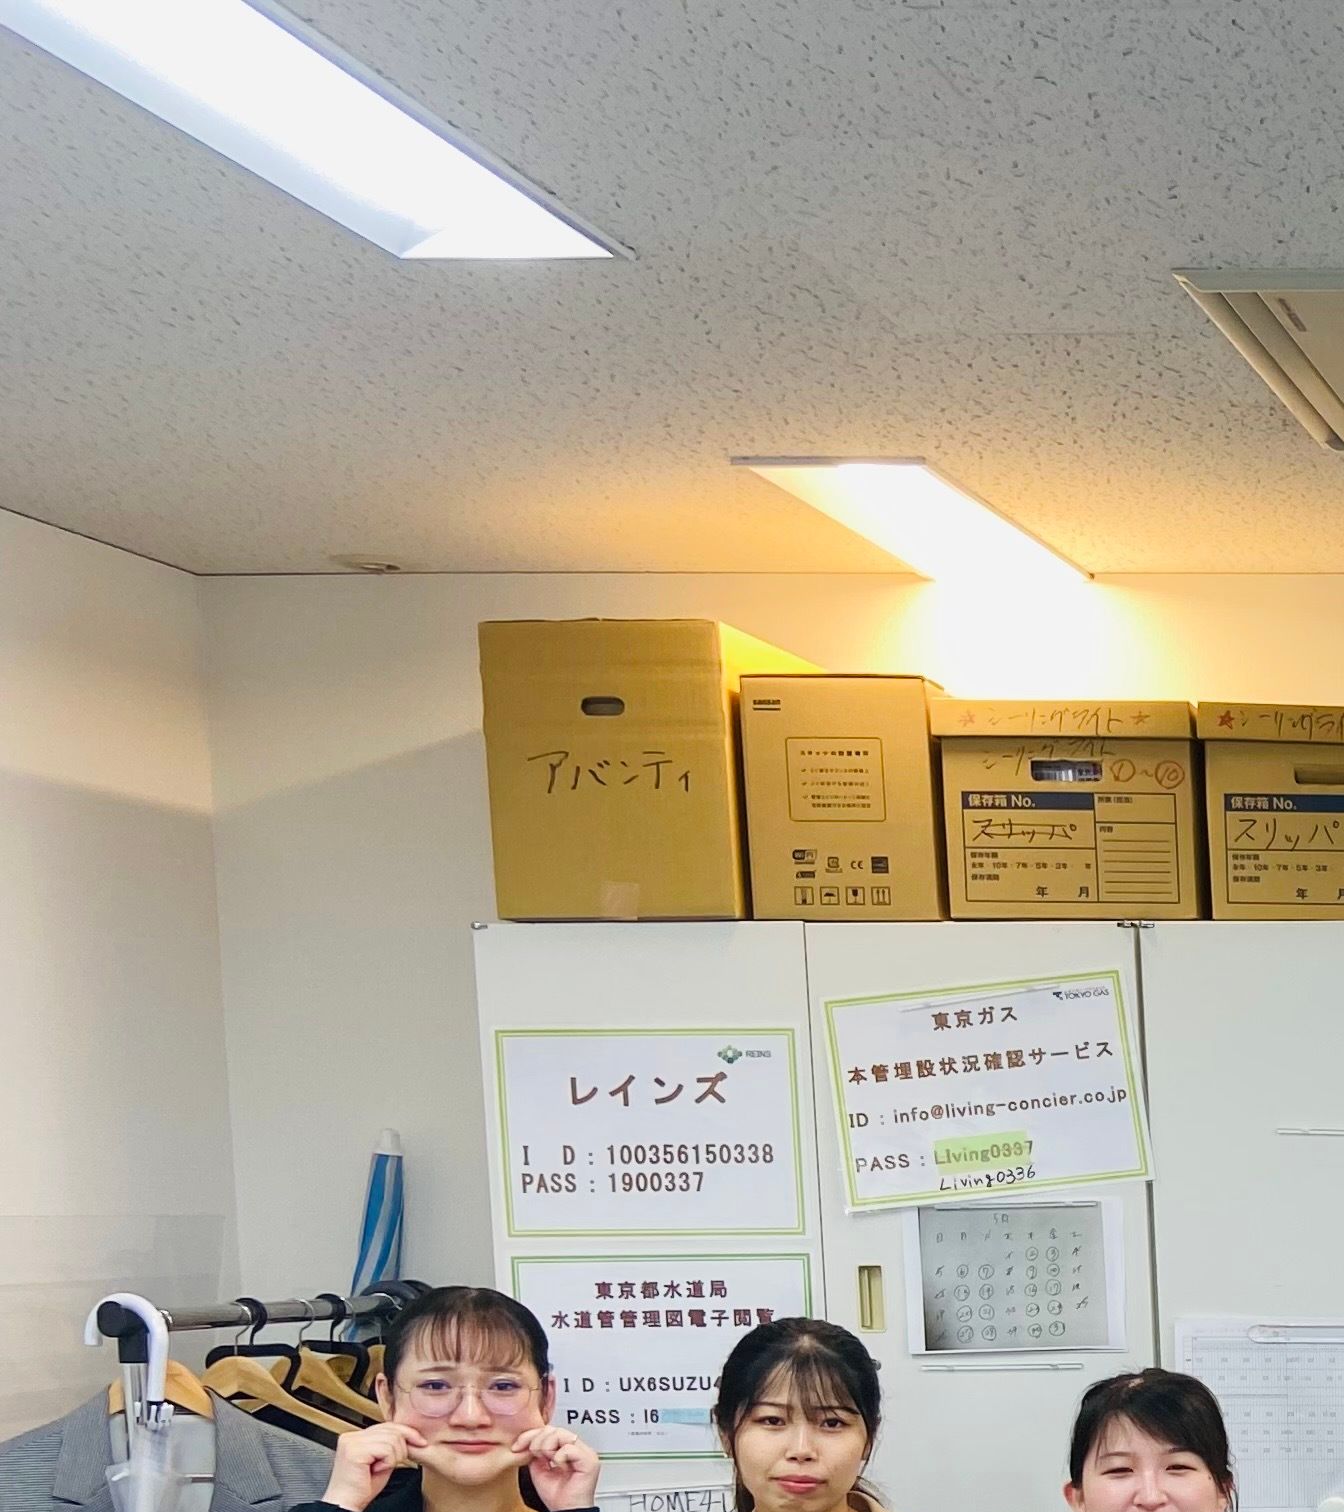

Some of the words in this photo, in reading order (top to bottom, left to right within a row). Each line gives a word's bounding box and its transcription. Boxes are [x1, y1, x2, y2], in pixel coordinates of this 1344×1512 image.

[527, 750, 690, 794] アバンティ
[968, 795, 1007, 807] 保存箱
[1011, 795, 1035, 807] No.
[1231, 797, 1269, 809] 保存箱
[1273, 798, 1297, 810] No.
[1234, 818, 1340, 851] スリッパ
[1036, 886, 1048, 897] 年
[1078, 886, 1089, 898] 月
[1296, 888, 1308, 898] 年
[932, 1005, 1017, 1031] 東京ガス
[848, 1041, 1113, 1085] 本管埋設状況確認サービス
[570, 1071, 728, 1107] レインズ
[607, 1144, 775, 1165] 100356150338
[856, 1153, 910, 1173] PASS
[521, 1173, 577, 1194] PASS
[608, 1171, 704, 1193] 1900337
[594, 1280, 728, 1300] 東京都水道局
[551, 1308, 775, 1330] 水道管管理図電子閲覧
[567, 1408, 620, 1425] PASS
